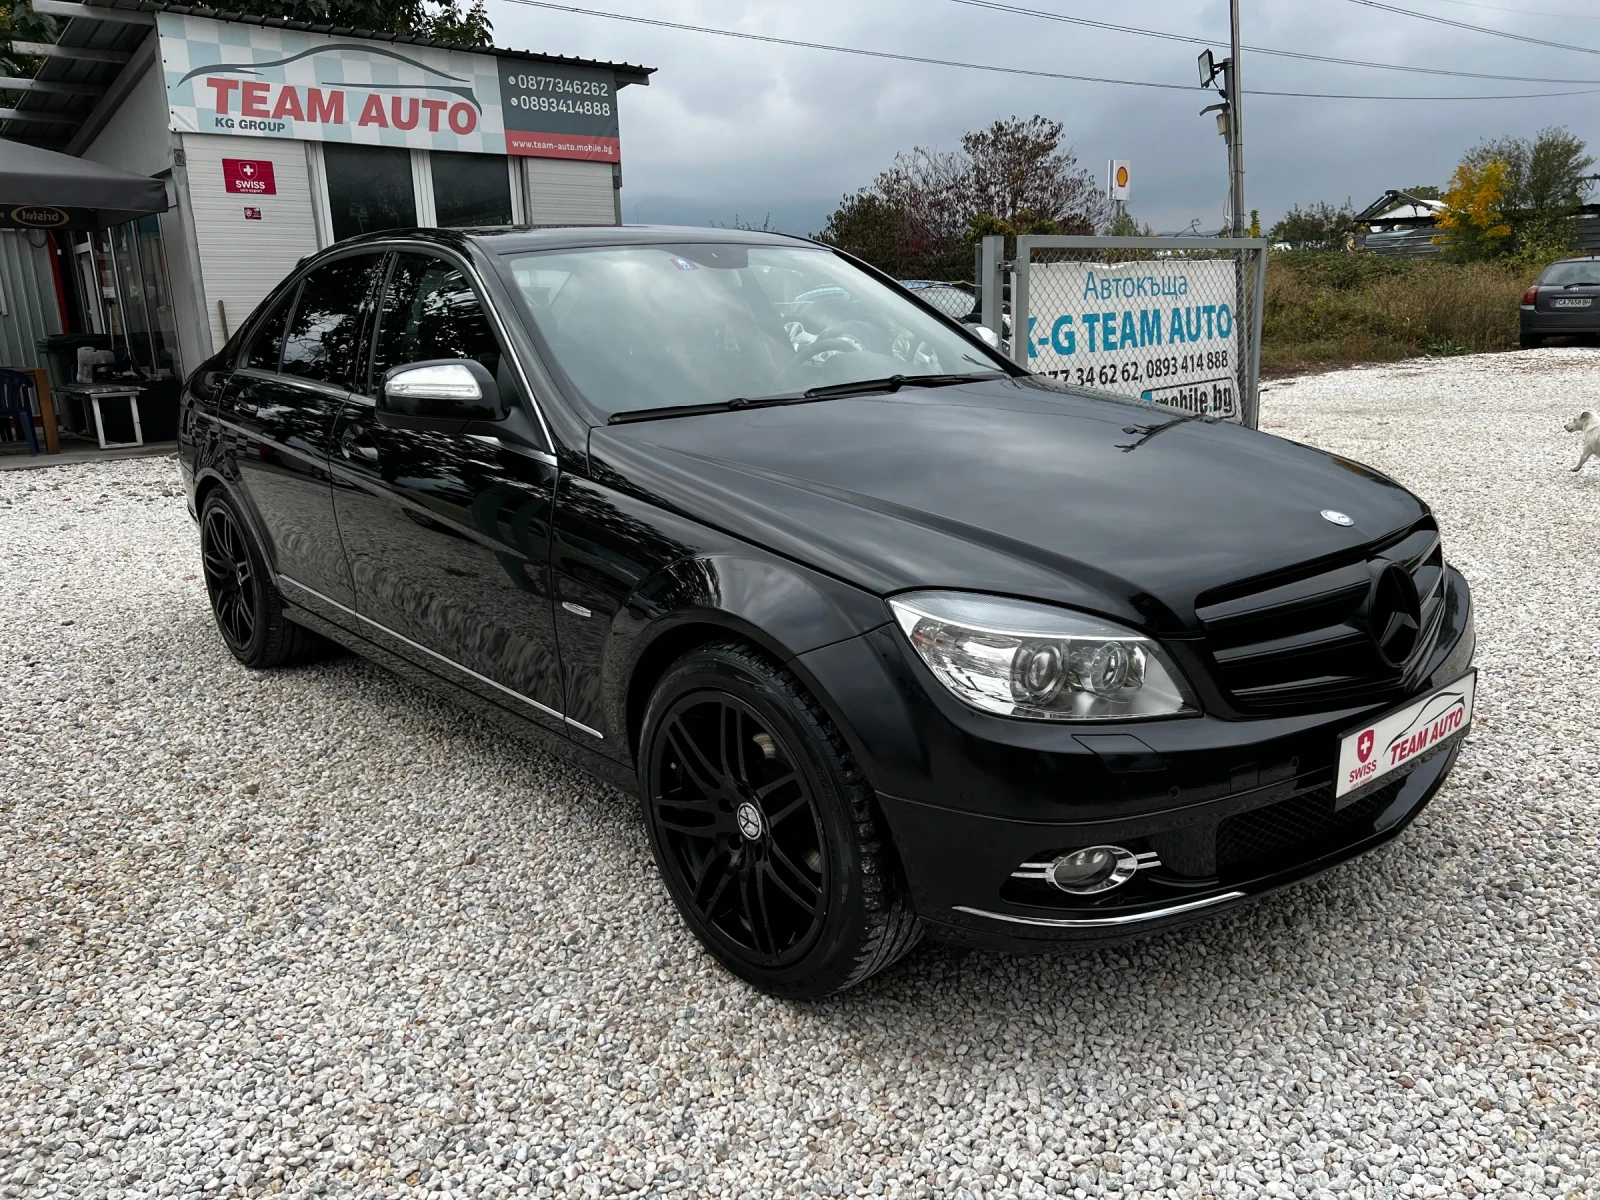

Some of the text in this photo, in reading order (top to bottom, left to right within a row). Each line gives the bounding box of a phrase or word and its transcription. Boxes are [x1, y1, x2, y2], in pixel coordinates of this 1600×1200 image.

[518, 74, 608, 96] 0877346262
[206, 77, 477, 135] TEAM AUTO
[520, 95, 611, 116] 0893414888
[215, 117, 285, 133] KG GROUP
[512, 140, 613, 154] www.team-auto.mobile.bg
[235, 180, 266, 189] SWISS
[1083, 271, 1188, 300] Автокъща
[1082, 309, 1162, 353] TEAM
[1169, 304, 1232, 344] AUTO
[1077, 367, 1095, 387] 34
[1099, 365, 1118, 385] 62
[1121, 362, 1143, 382] 62,
[1146, 357, 1178, 379] 0893
[1181, 354, 1204, 373] 414
[1206, 350, 1228, 369] 888
[1390, 706, 1463, 766] TEAM AUTO
[1349, 759, 1377, 783] SWISS
